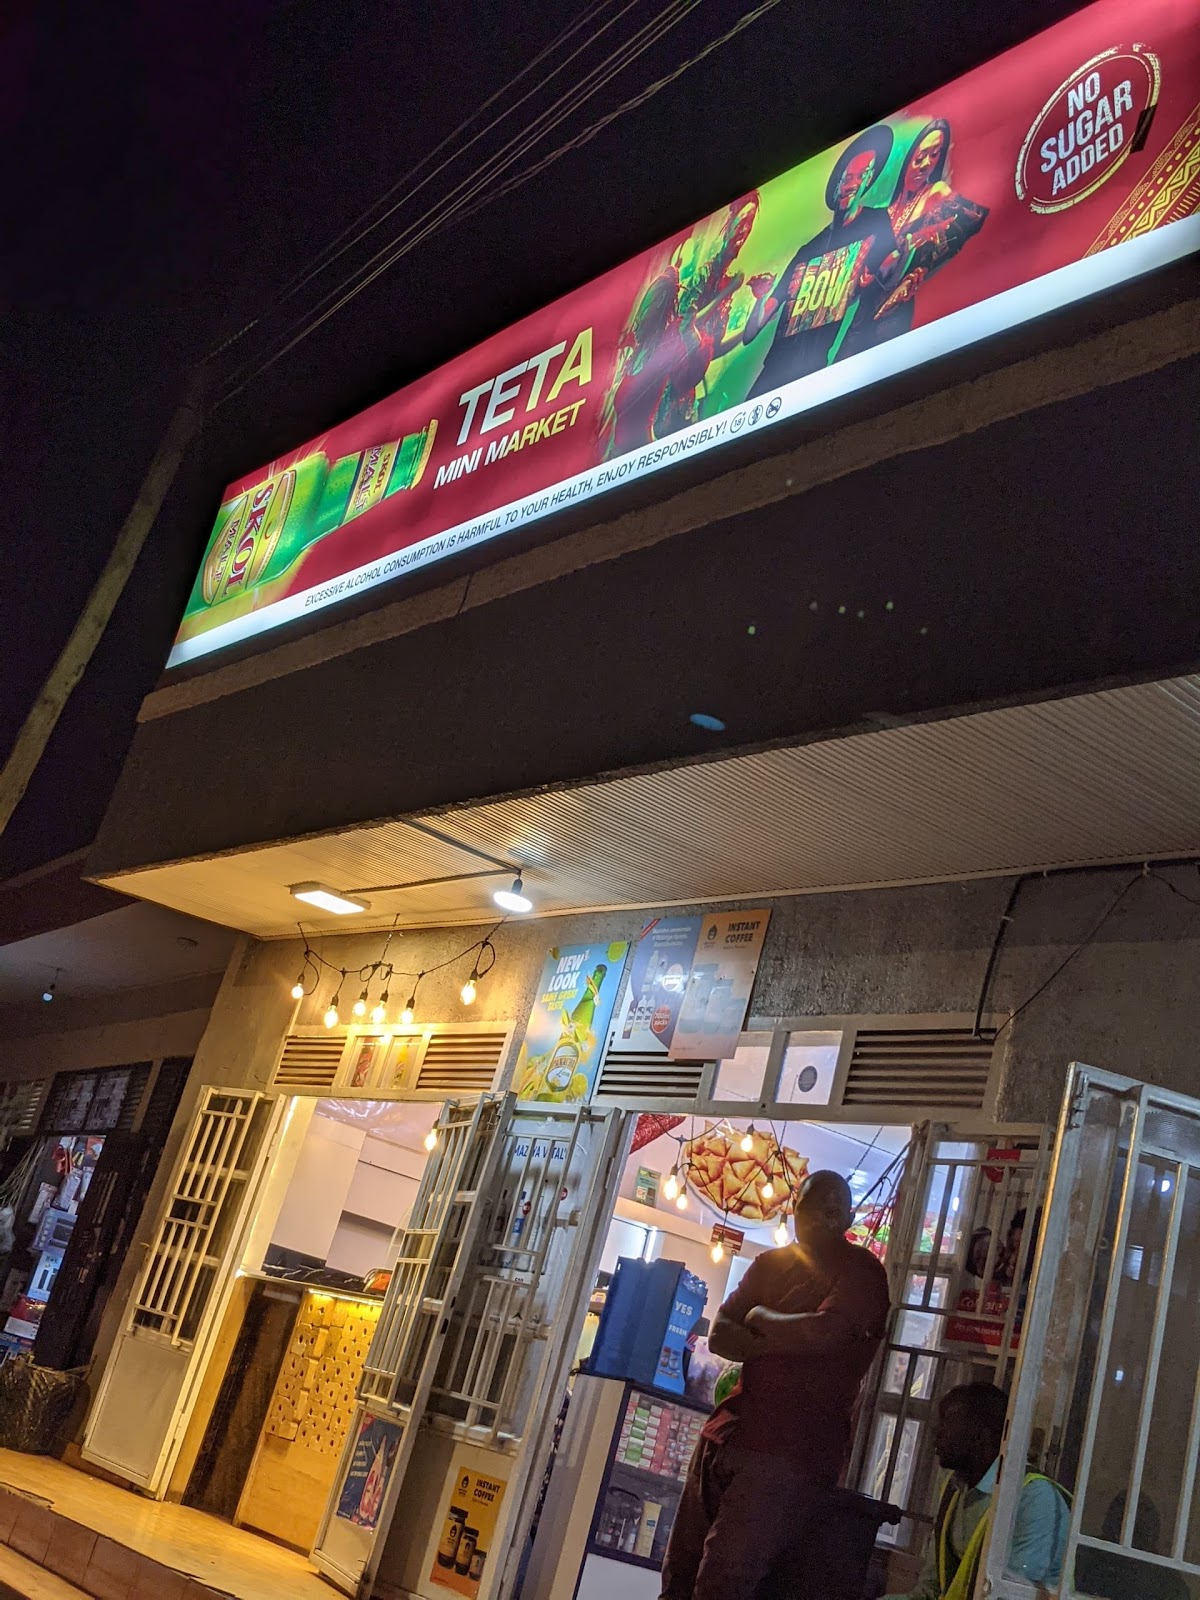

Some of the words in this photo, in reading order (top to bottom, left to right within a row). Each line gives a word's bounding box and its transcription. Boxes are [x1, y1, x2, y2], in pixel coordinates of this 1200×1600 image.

[1067, 71, 1101, 119] NO
[1040, 79, 1133, 174] SUGAR
[1051, 122, 1124, 197] ADDED
[456, 326, 593, 447] TETA
[433, 447, 483, 490] MINI
[484, 398, 587, 467] MARKET
[305, 581, 346, 607] EXCESSIVE
[344, 565, 382, 591] ALCOHOL
[383, 541, 447, 575] CONSUMPTION
[446, 537, 457, 549] IS
[457, 517, 502, 543] HARMFUL
[505, 509, 519, 526] TO
[521, 496, 550, 520] YOUR
[550, 477, 593, 506] HEALTH,
[596, 459, 636, 488] ENJOY
[637, 421, 727, 471] RESPONSIBLY!
[213, 518, 241, 582] MALT
[221, 483, 275, 598] SKOL
[725, 933, 753, 944] COFFEE
[728, 921, 761, 933] INSTANT
[547, 972, 581, 993] LOOK
[556, 952, 584, 975] NEW
[674, 1300, 694, 1317] YES
[473, 1488, 495, 1502] COFFEE
[475, 1478, 501, 1494] INSTANT
